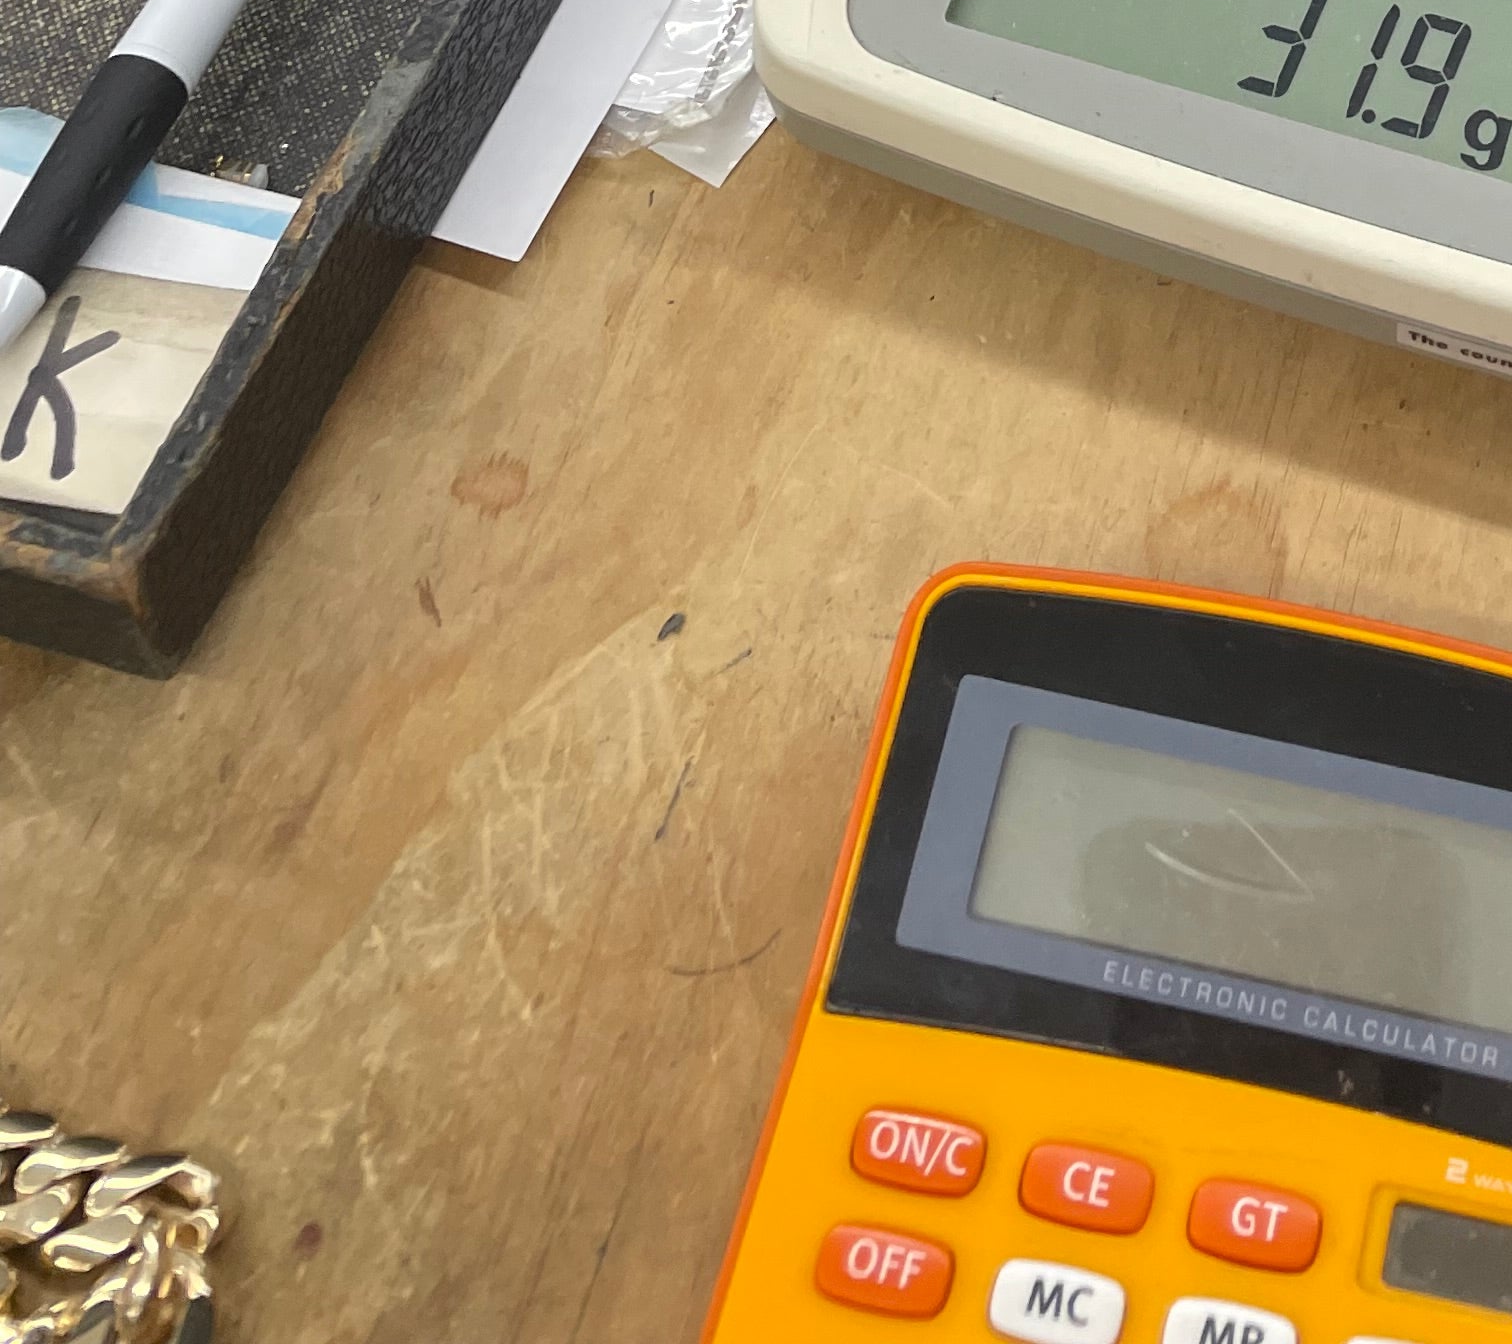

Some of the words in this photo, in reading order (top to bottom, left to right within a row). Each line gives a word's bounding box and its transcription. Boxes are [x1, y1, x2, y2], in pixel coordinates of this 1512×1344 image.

[1408, 330, 1448, 350] The
[1102, 960, 1288, 1020] ELECTRONIC
[1303, 1005, 1499, 1068] CALCULATOR
[869, 1119, 975, 1176] ON/C
[1445, 1157, 1469, 1184] 2
[1062, 1161, 1115, 1207] CE
[1230, 1197, 1288, 1242] GT
[846, 1238, 927, 1289] OFF
[1026, 1277, 1095, 1326] MC
